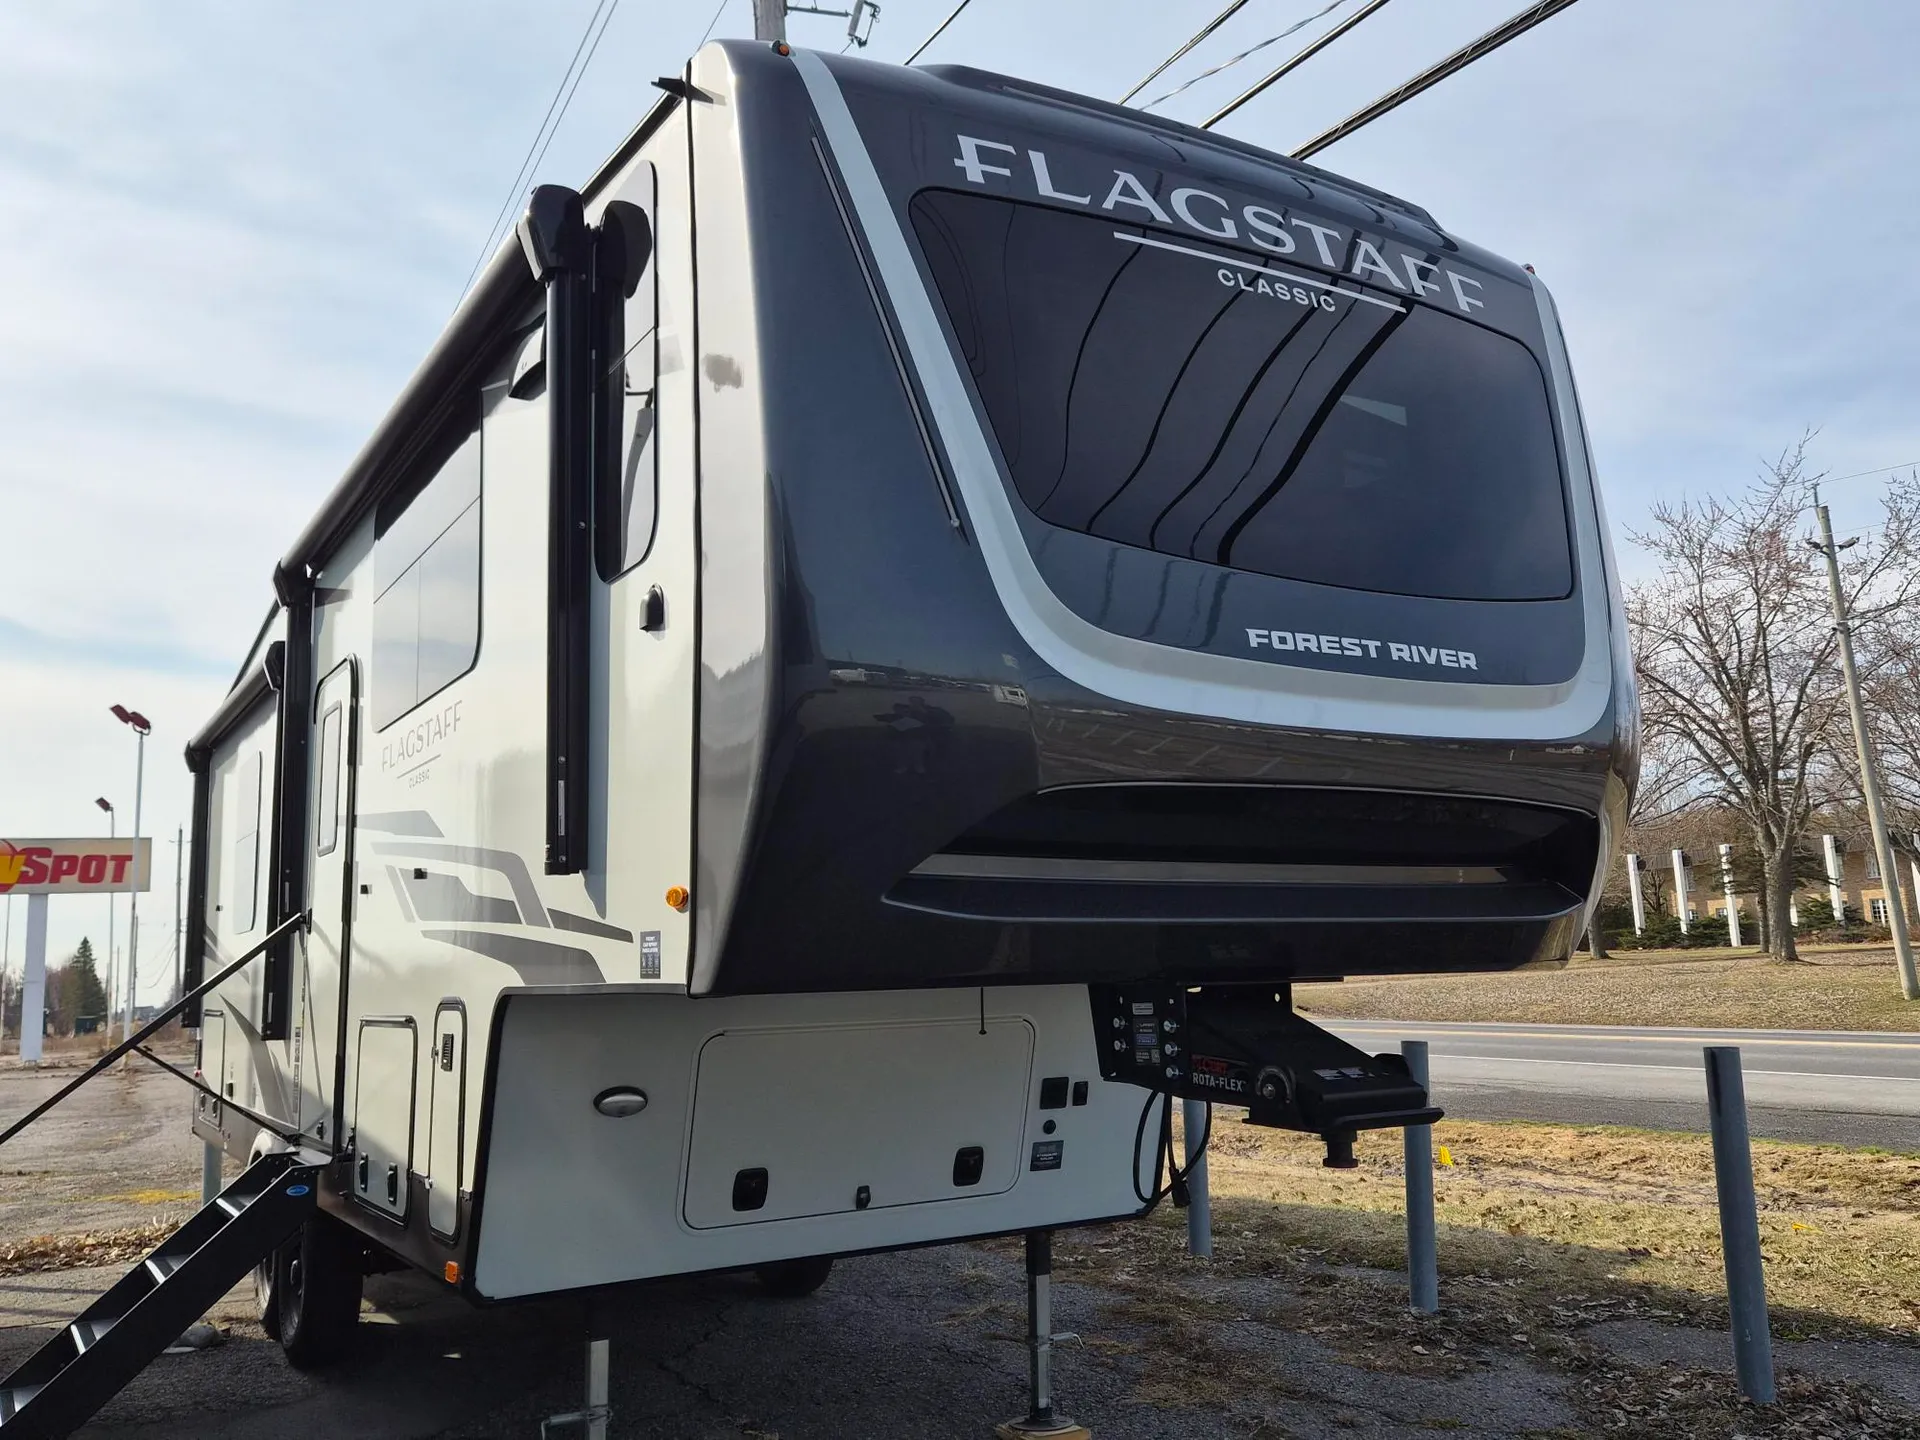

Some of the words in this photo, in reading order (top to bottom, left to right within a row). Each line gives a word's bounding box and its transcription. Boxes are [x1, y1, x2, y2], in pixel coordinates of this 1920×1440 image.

[953, 134, 1484, 313] FLAGSTAFF
[1217, 267, 1337, 313] CLASSIC
[1245, 628, 1381, 659] FOREST
[1387, 642, 1479, 670] RIVER
[382, 700, 463, 773] FLAGSTAFF
[1192, 1072, 1244, 1093] ROTA-FLEX
